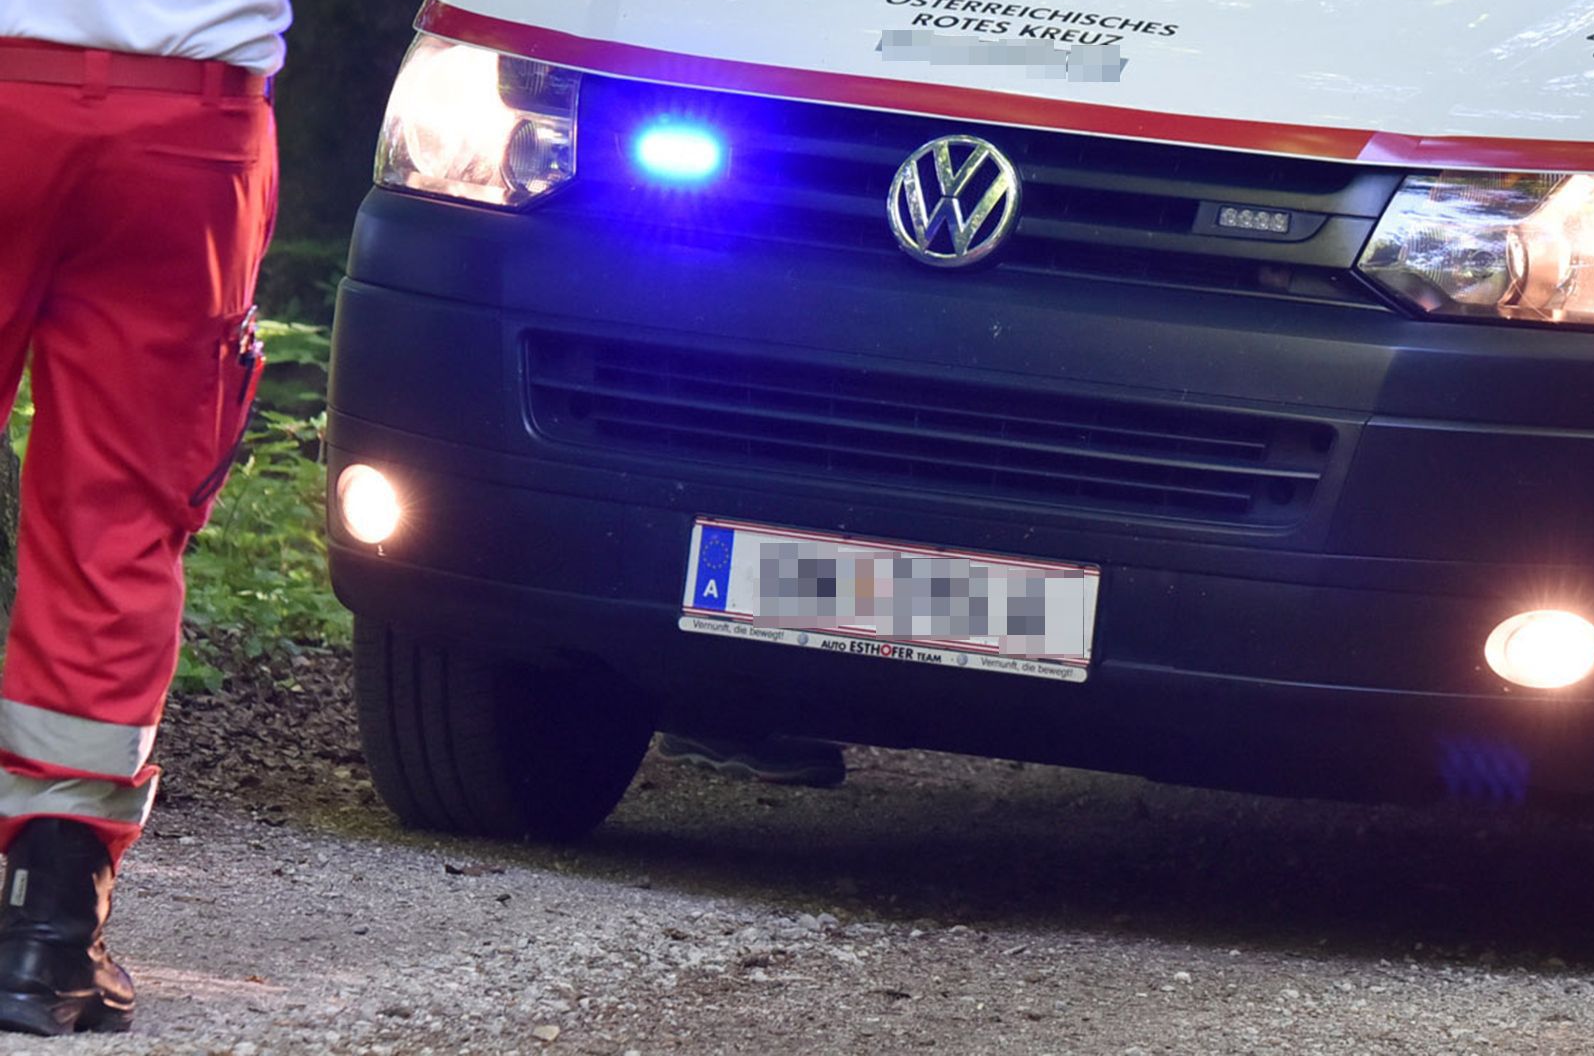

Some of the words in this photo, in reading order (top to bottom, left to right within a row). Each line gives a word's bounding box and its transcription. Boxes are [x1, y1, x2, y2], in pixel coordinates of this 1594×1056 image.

[911, 13, 1011, 34] ROTES
[1018, 24, 1124, 46] KREUZ
[893, 136, 1015, 262] VW
[703, 581, 718, 599] A
[734, 625, 746, 635] die
[821, 640, 846, 651] AUTO
[849, 641, 913, 659] ESTHOFER
[917, 652, 941, 663] TEAM
[1022, 663, 1035, 673] die
